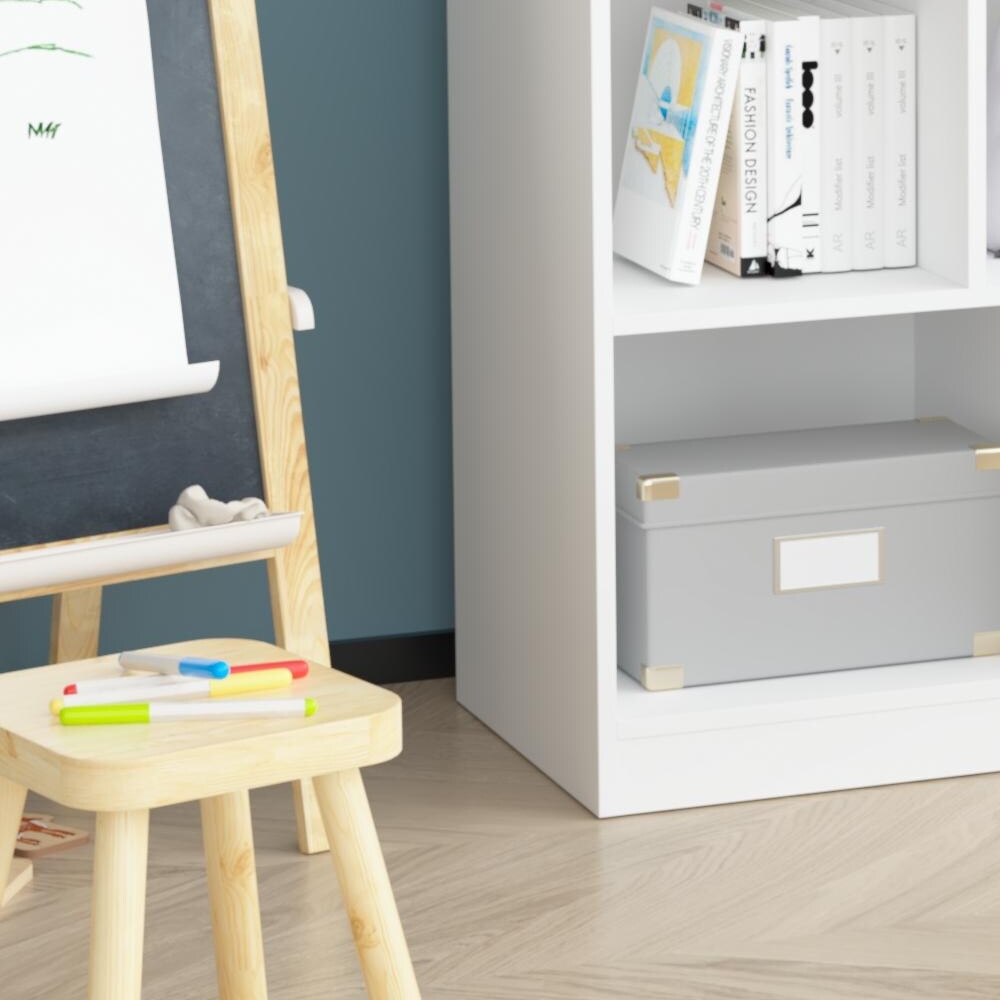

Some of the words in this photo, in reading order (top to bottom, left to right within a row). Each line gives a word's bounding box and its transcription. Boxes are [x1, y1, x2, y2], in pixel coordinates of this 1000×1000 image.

[708, 77, 725, 136] ARCHITECTURE
[835, 84, 843, 118] volume
[867, 82, 875, 116] volume
[898, 81, 907, 114] volume
[744, 87, 757, 153] FASHION
[700, 148, 714, 167] THE
[705, 136, 716, 148] OF
[867, 156, 875, 169] list
[898, 154, 907, 167] list
[744, 159, 758, 214] DESIGN
[835, 172, 843, 212] Modifier
[867, 170, 875, 209] Modifier
[898, 168, 907, 207] Modifier
[832, 232, 843, 252] AR
[865, 230, 875, 250] AR
[897, 229, 907, 248] AR
